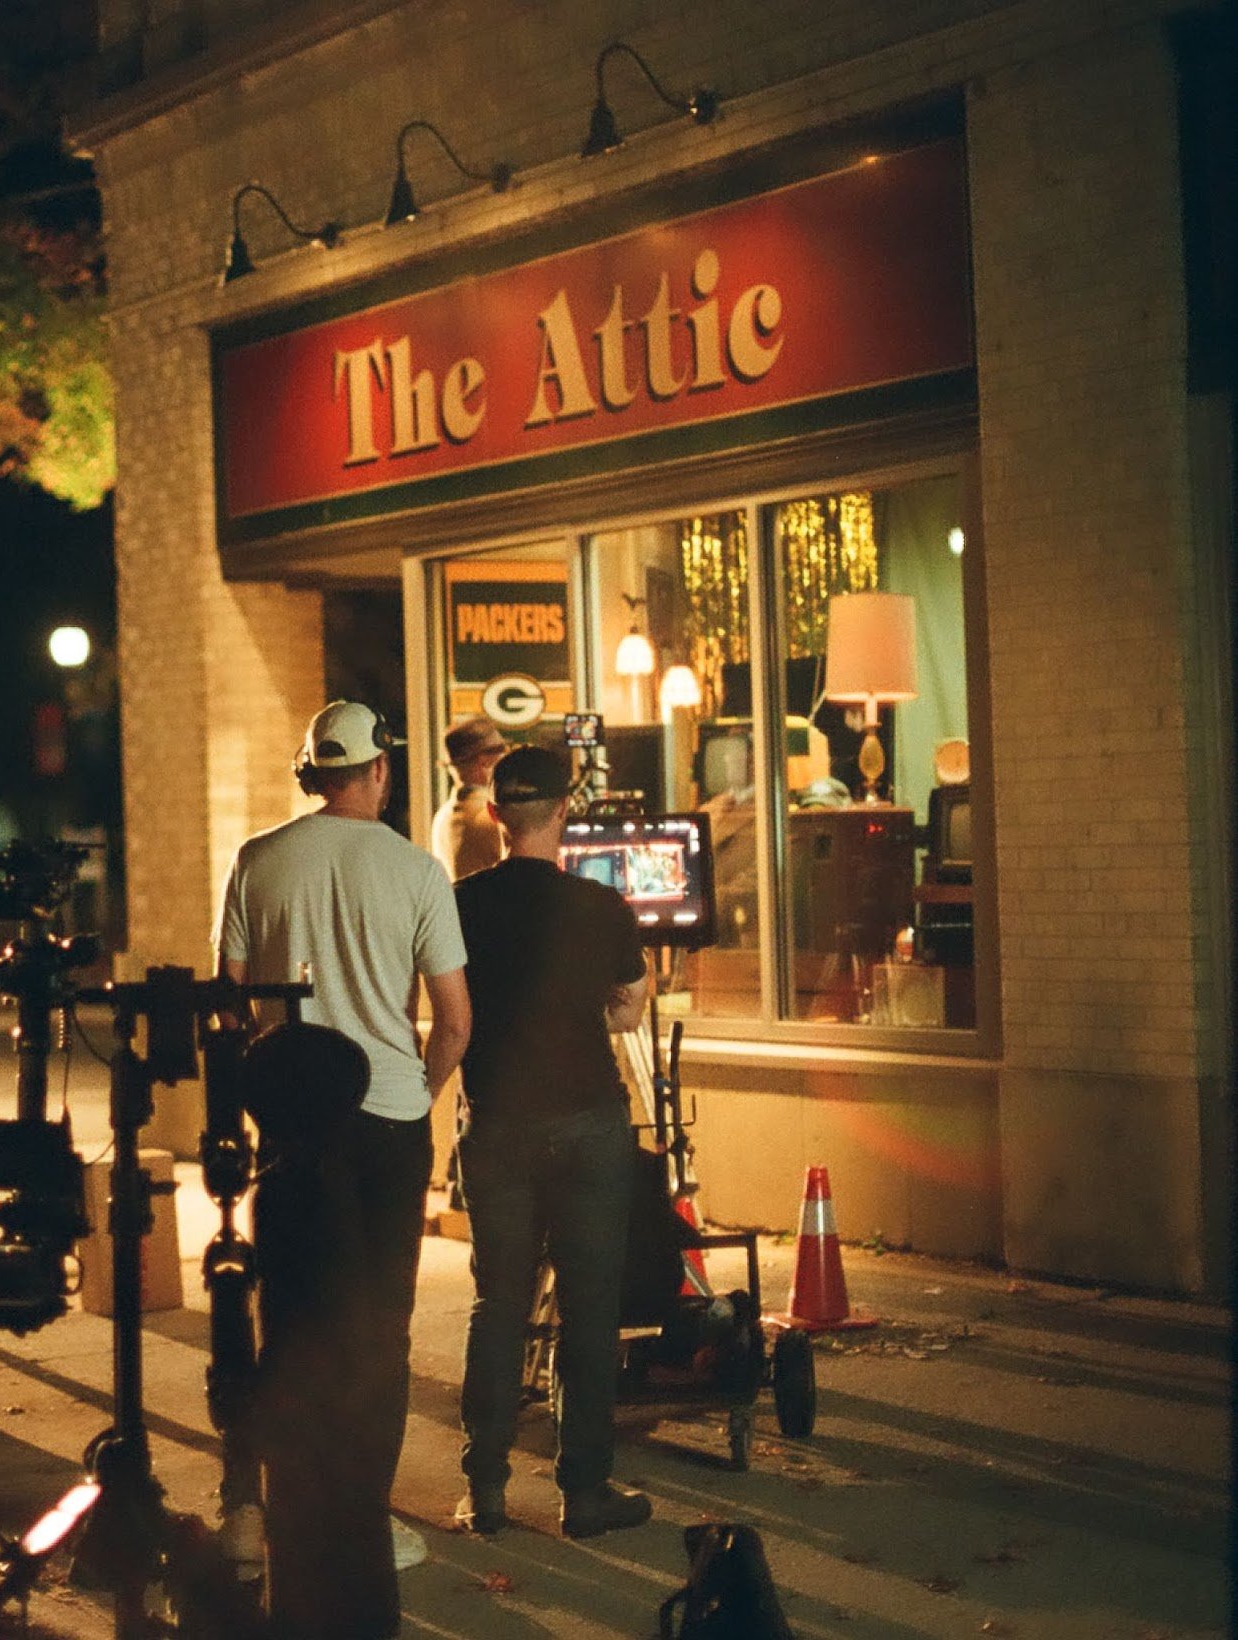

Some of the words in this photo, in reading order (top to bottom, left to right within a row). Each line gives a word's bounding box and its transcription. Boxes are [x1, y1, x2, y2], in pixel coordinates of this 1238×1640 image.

[335, 334, 488, 468] The
[524, 249, 784, 430] Attic
[456, 602, 566, 643] PACKERS
[483, 677, 545, 726] G
